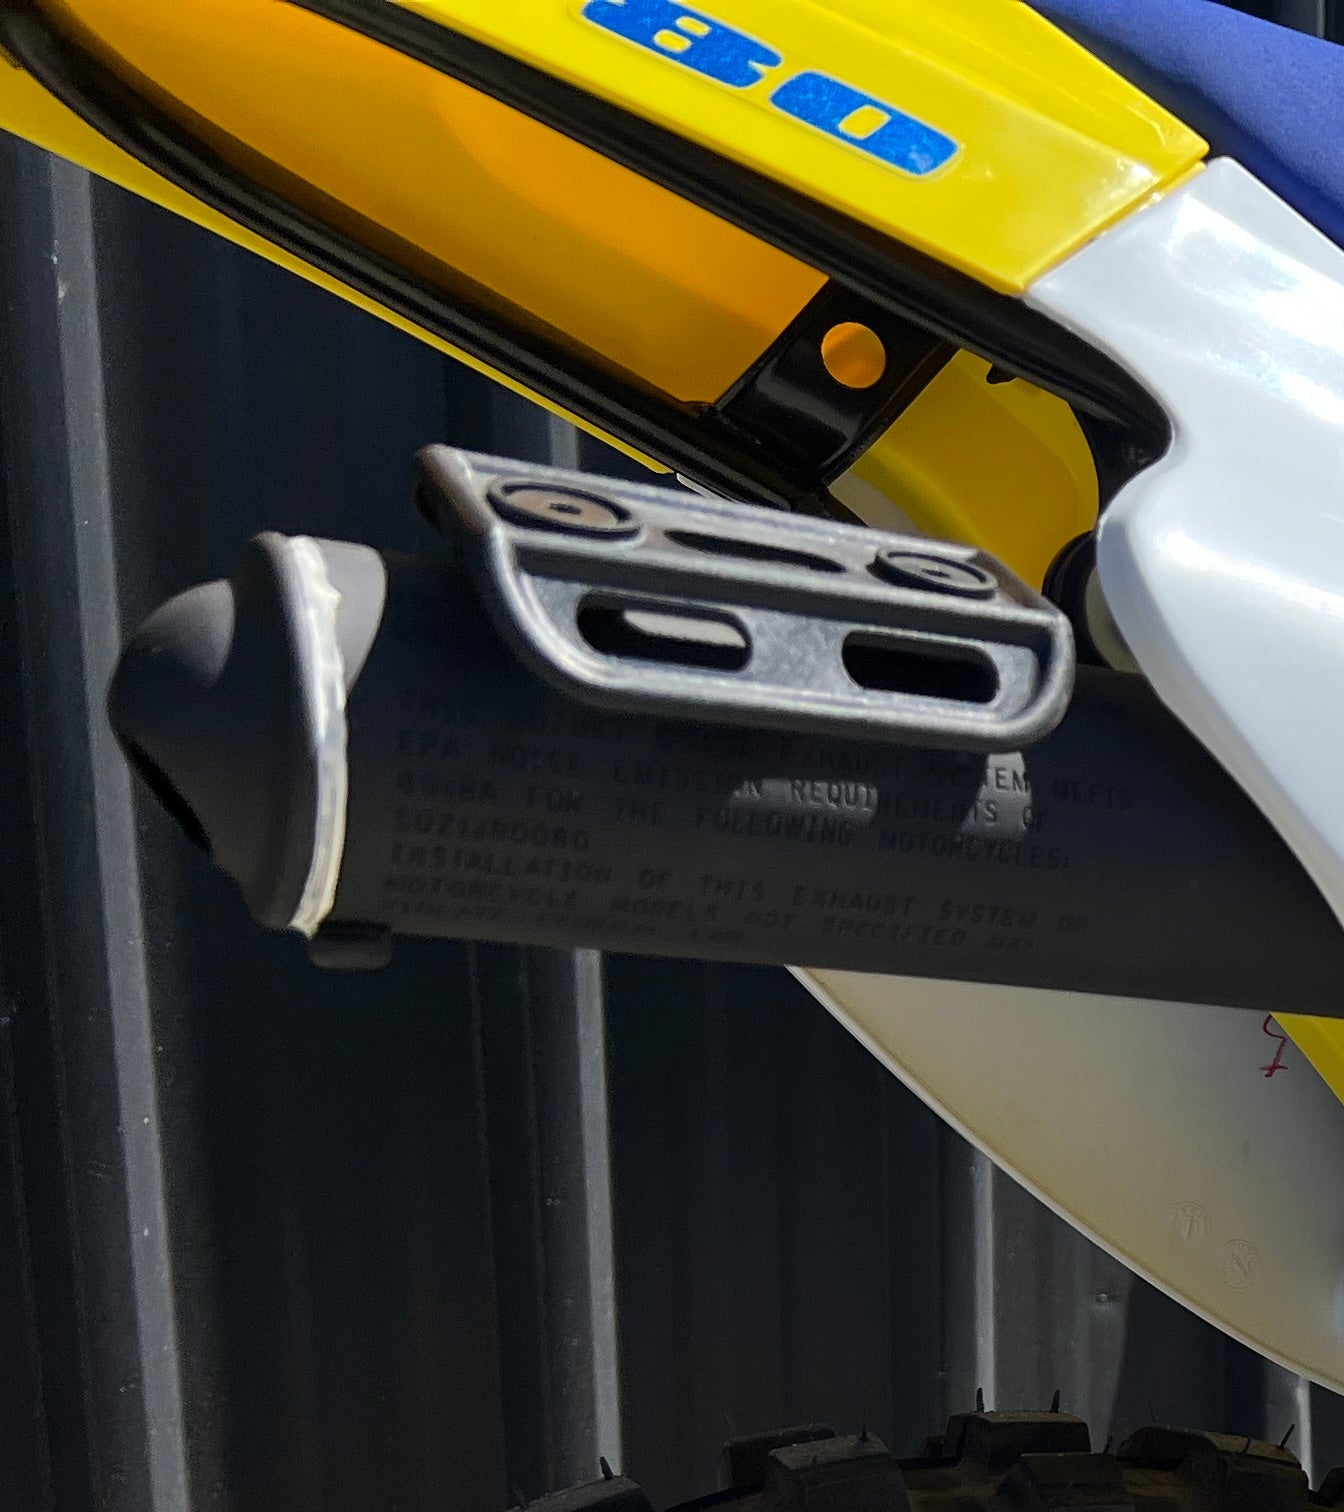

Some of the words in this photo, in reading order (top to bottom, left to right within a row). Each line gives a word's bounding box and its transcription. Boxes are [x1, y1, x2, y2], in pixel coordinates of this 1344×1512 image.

[580, 0, 962, 178] 80
[694, 806, 853, 848] FOLLOWING
[391, 842, 612, 886] INSTALLATION
[699, 873, 765, 903] THIS
[791, 882, 916, 917] EXHAUST
